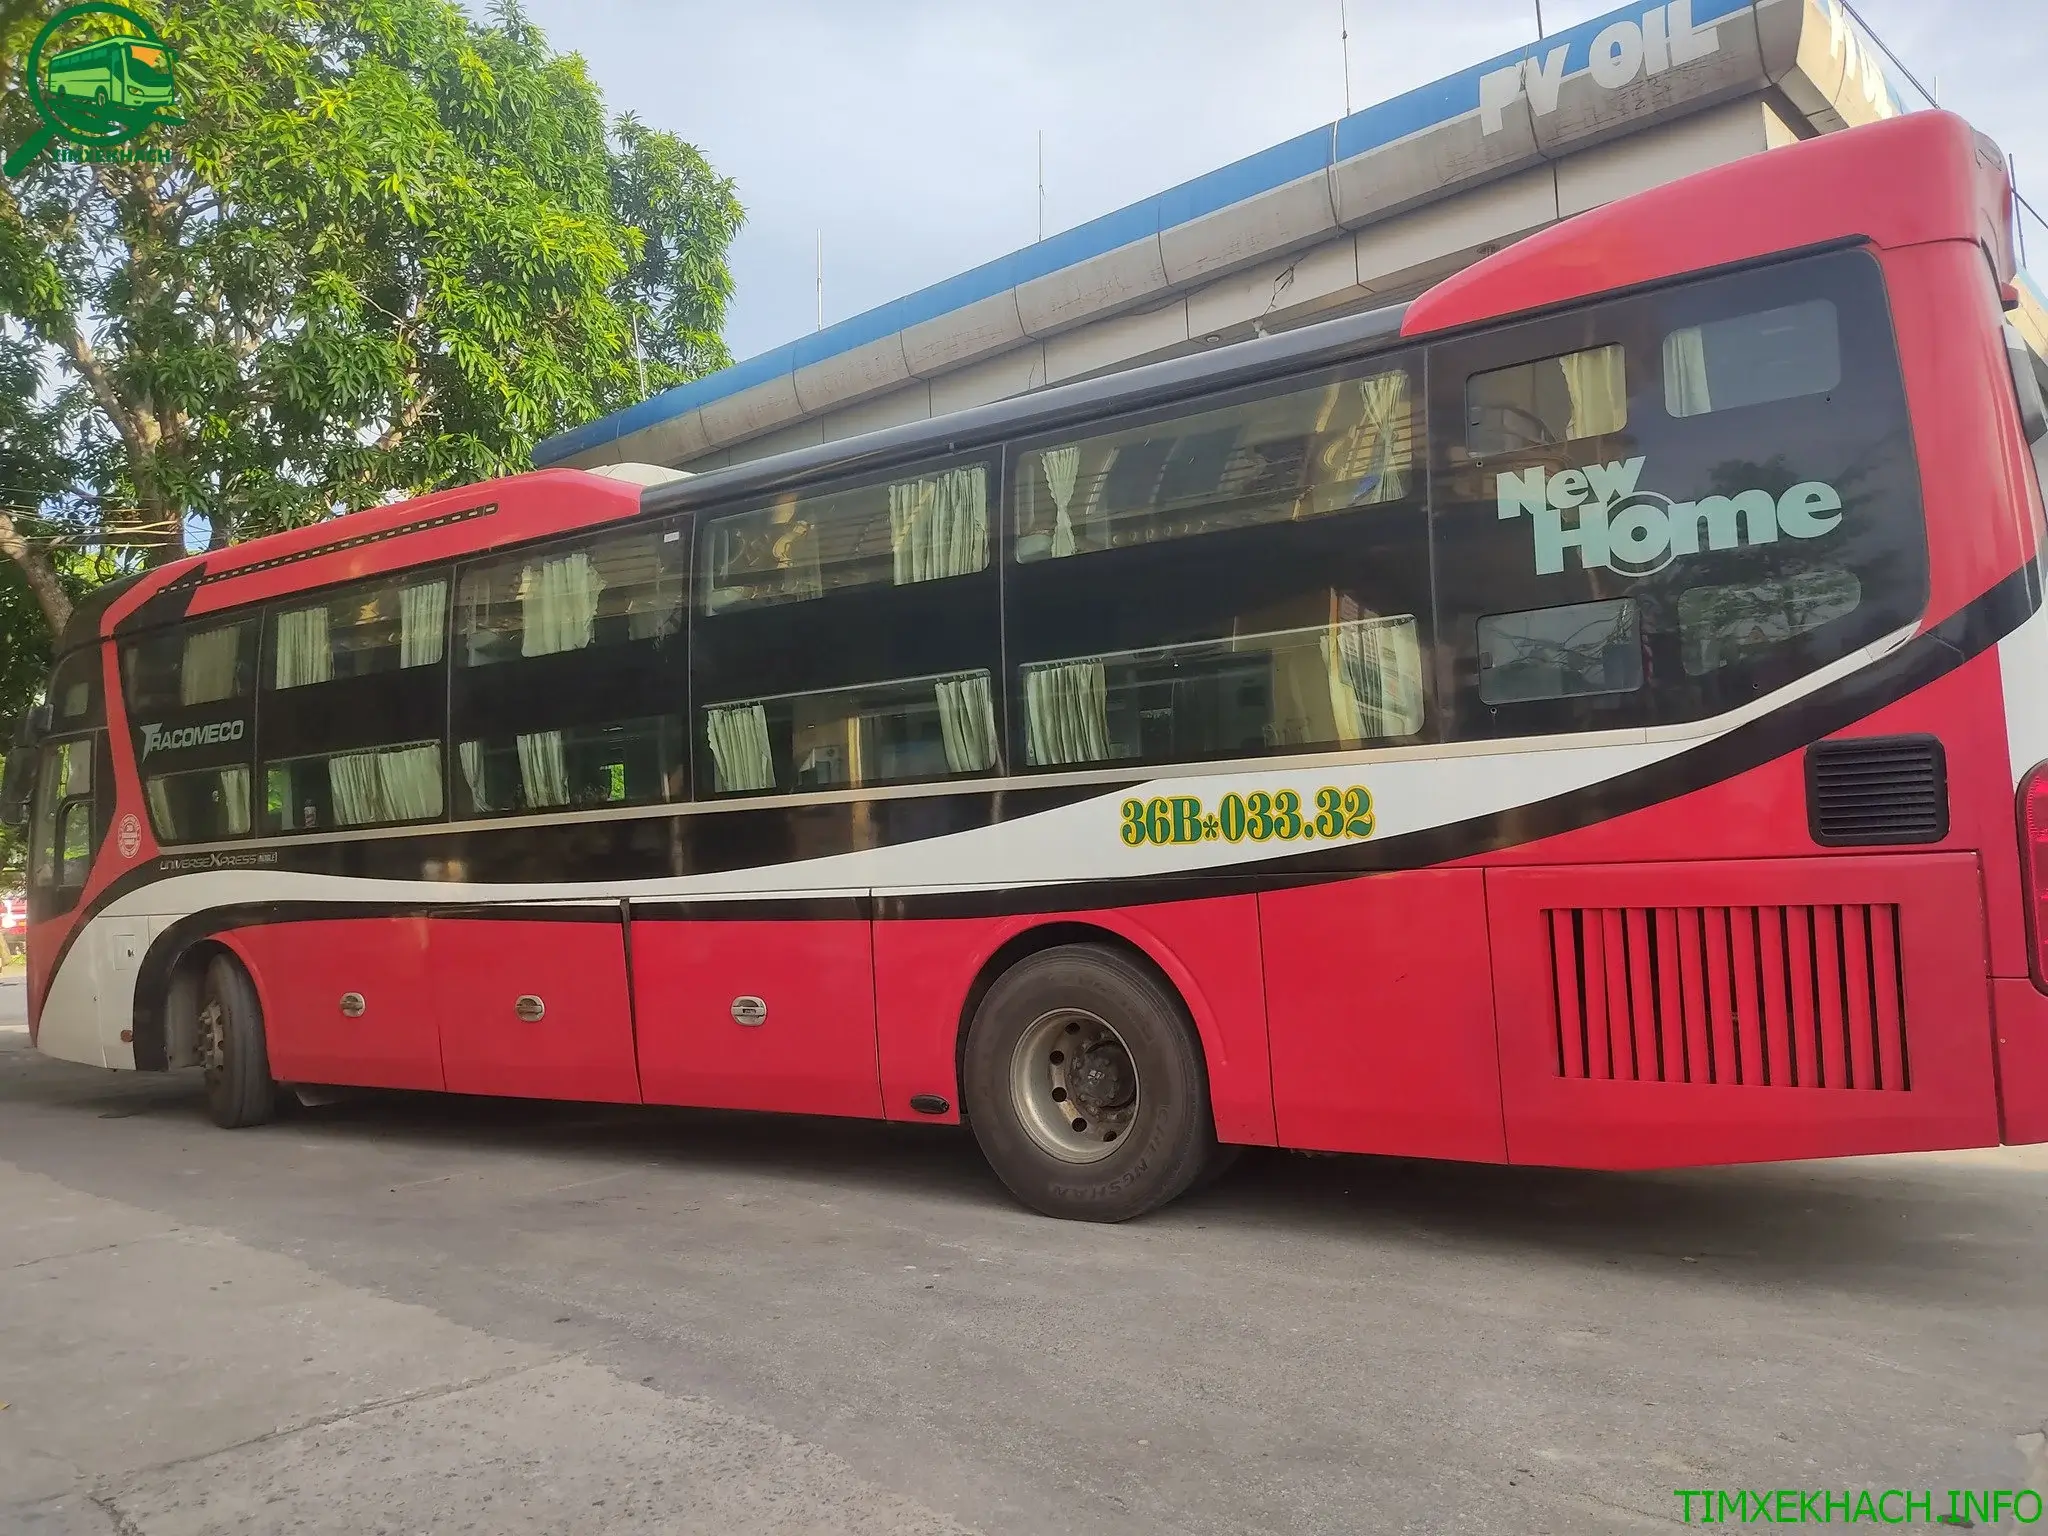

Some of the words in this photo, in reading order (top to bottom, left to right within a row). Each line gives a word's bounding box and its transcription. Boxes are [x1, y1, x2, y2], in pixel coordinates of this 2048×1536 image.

[1480, 43, 1570, 137] PV
[1588, 0, 1720, 89] OIL
[1496, 455, 1647, 520] New
[1532, 481, 1843, 577] Home
[140, 720, 244, 767] TRACOMECO
